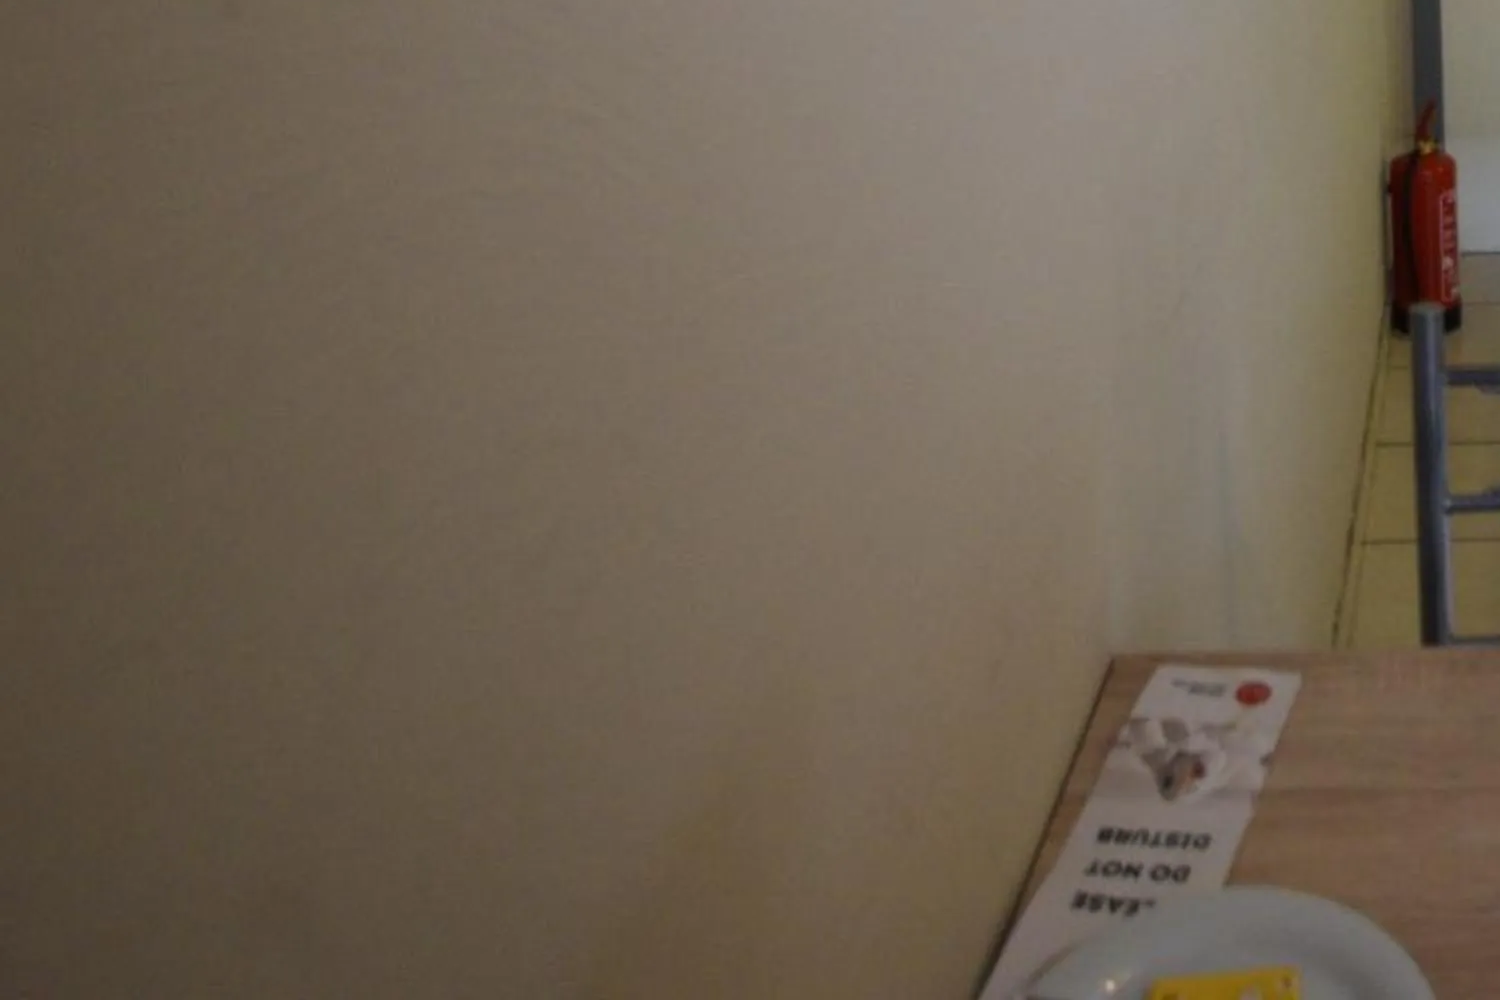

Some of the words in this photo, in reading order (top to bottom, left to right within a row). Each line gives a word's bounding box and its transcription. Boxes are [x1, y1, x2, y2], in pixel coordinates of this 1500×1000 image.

[1096, 827, 1212, 850] DISTURB
[1084, 859, 1143, 880] NOT
[1149, 865, 1191, 885] DO
[1070, 892, 1156, 918] EASE
